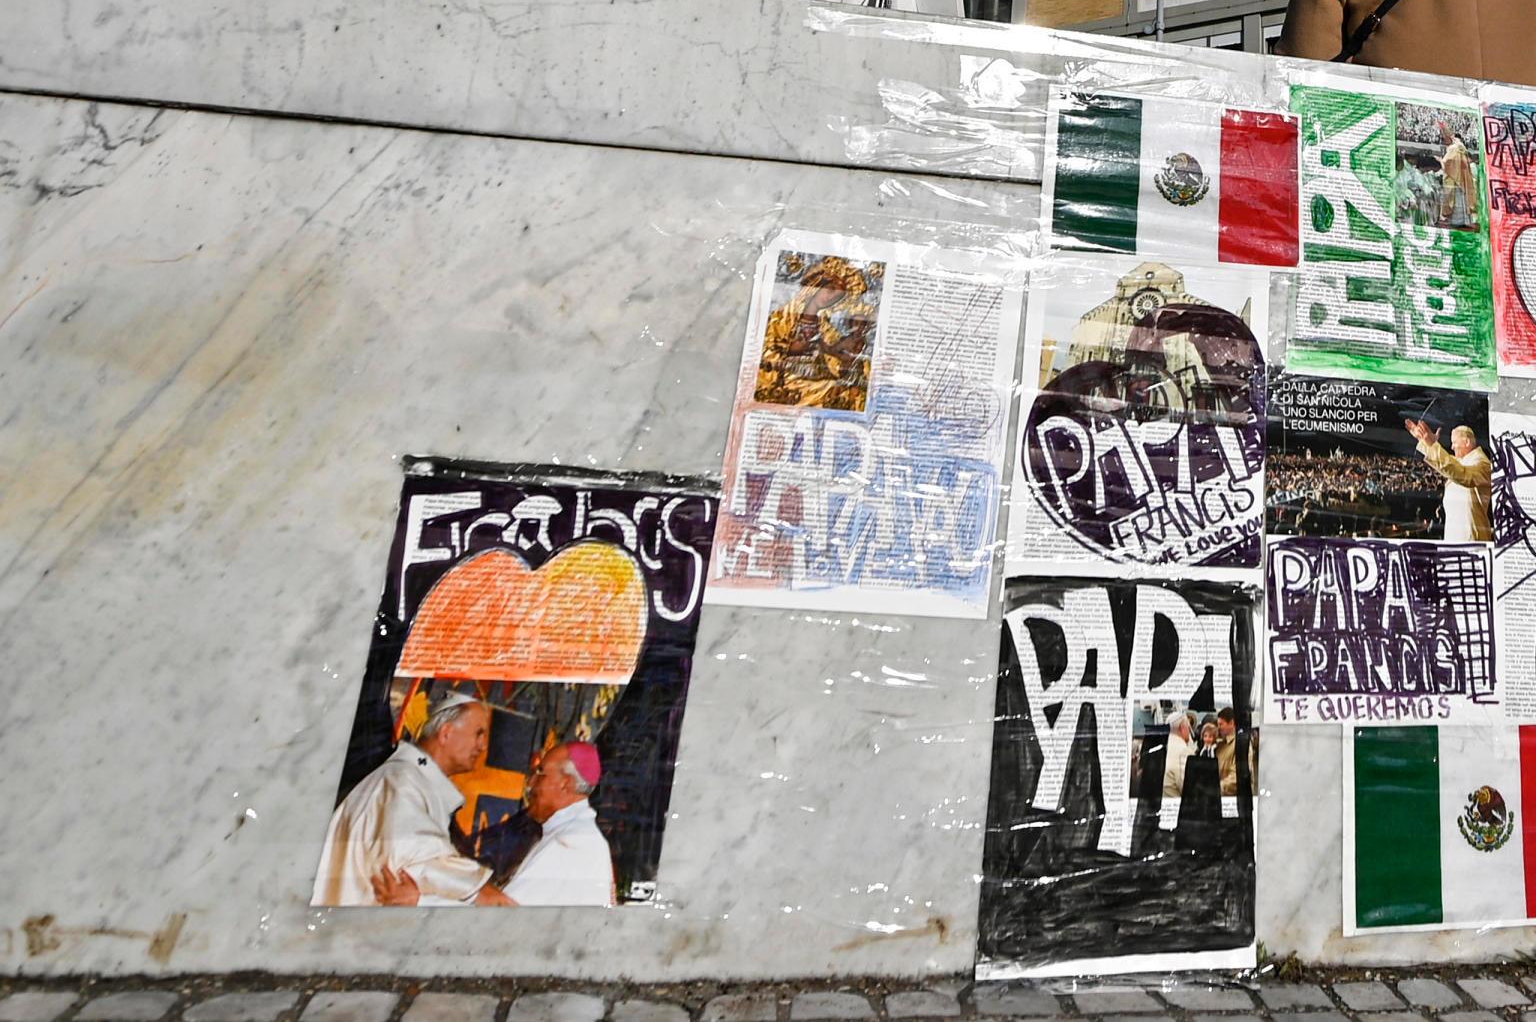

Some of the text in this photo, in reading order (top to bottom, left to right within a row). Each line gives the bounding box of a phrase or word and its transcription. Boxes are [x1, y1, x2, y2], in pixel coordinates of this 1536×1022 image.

[1282, 381, 1376, 396] DALLA CATTEDRA
[1281, 394, 1361, 408] DI SAN NICOLA
[1282, 406, 1377, 421] UNO SLANCIO PER
[1282, 418, 1364, 433] L'ECUMENISMO
[1274, 546, 1417, 633] PAPA
[1274, 695, 1452, 722] TE QUEREMOS
